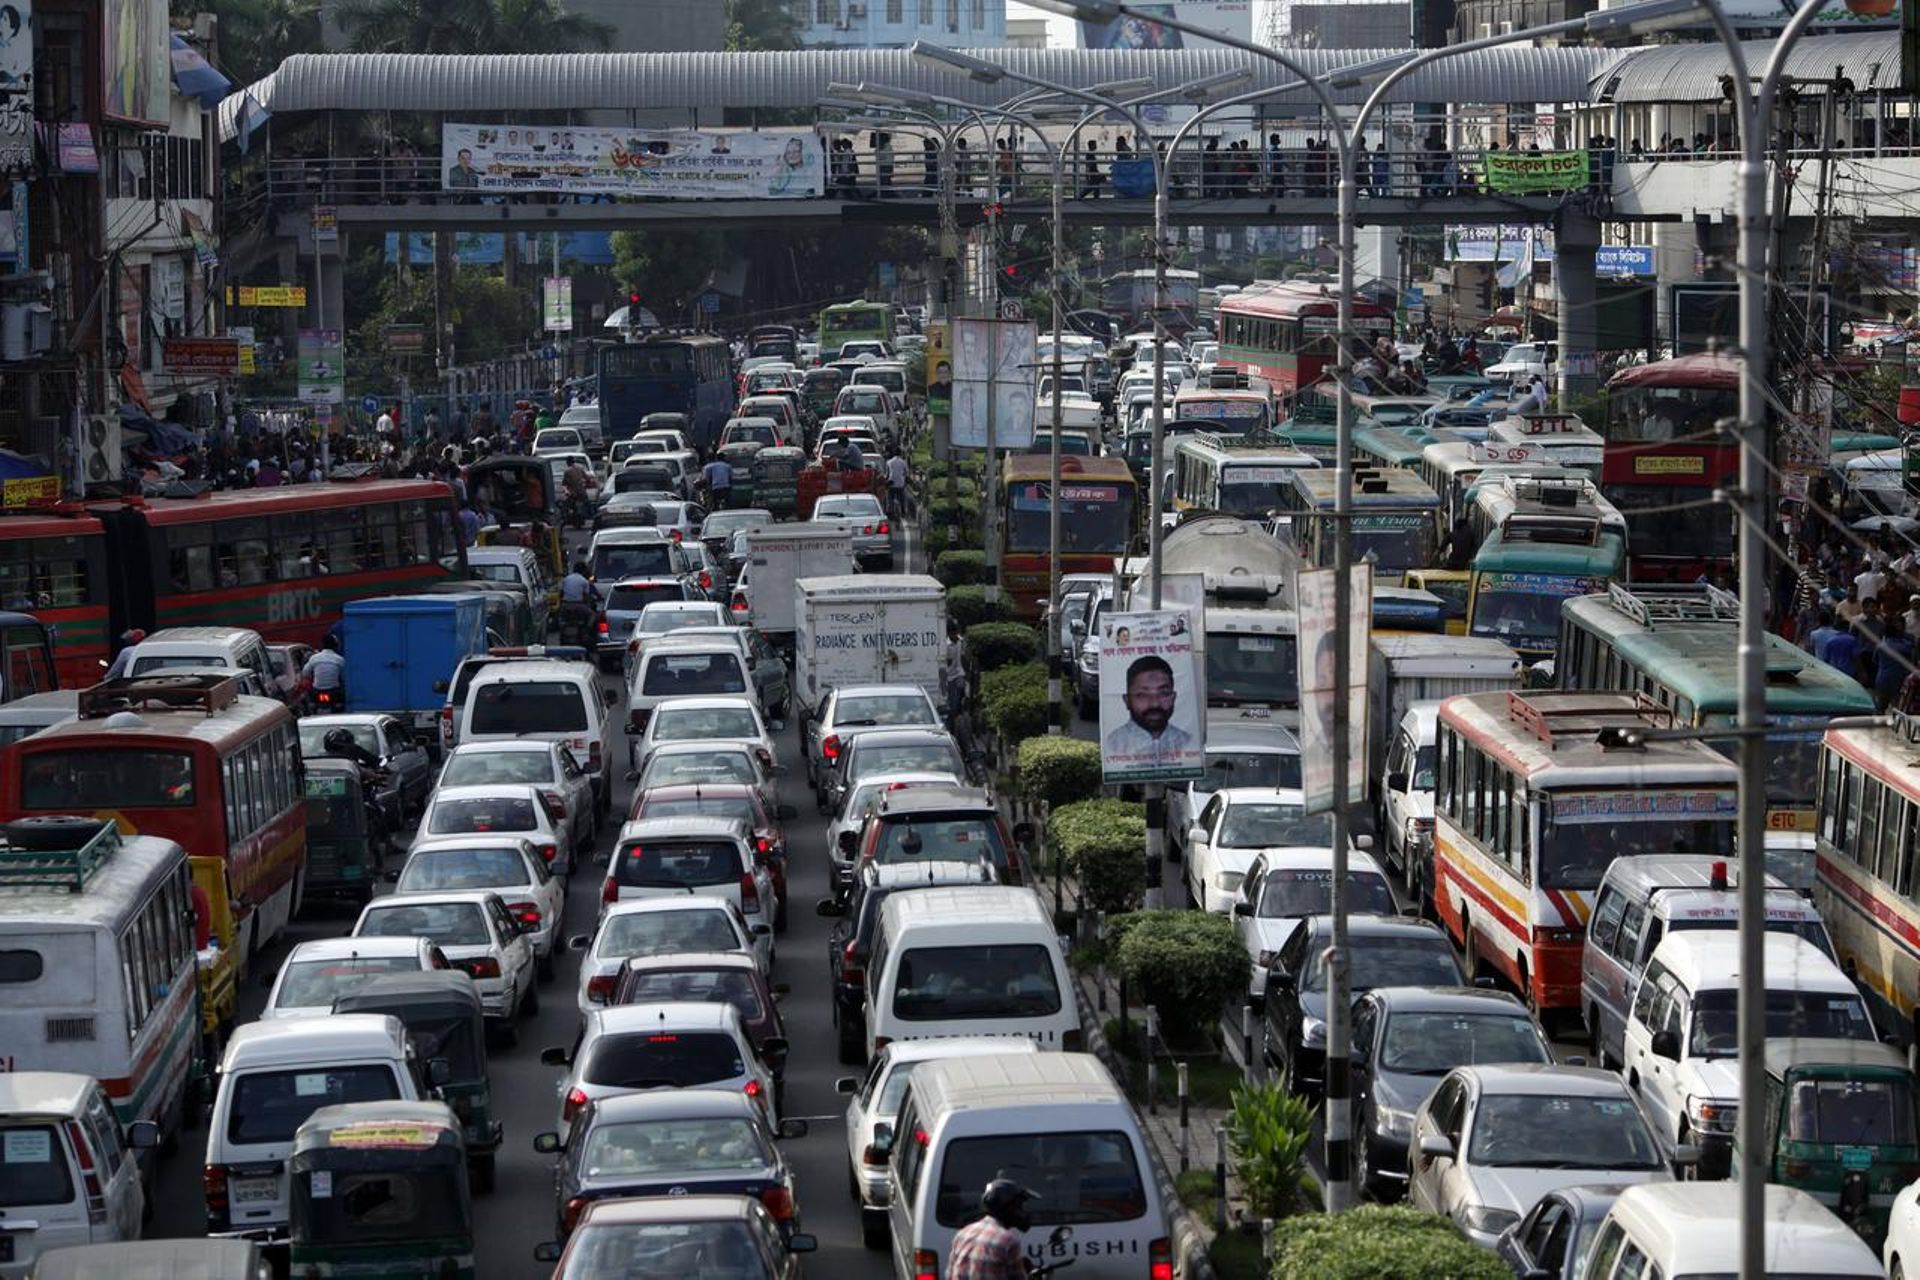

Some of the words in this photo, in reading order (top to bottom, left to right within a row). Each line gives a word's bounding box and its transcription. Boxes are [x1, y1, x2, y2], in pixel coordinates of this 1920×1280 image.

[1552, 155, 1581, 171] BCS
[1530, 418, 1574, 435] BTL
[268, 588, 321, 622] BRTC
[816, 632, 856, 649] RADIANCE
[1771, 812, 1797, 828] ETC
[1027, 1239, 1138, 1258] UBISHI
